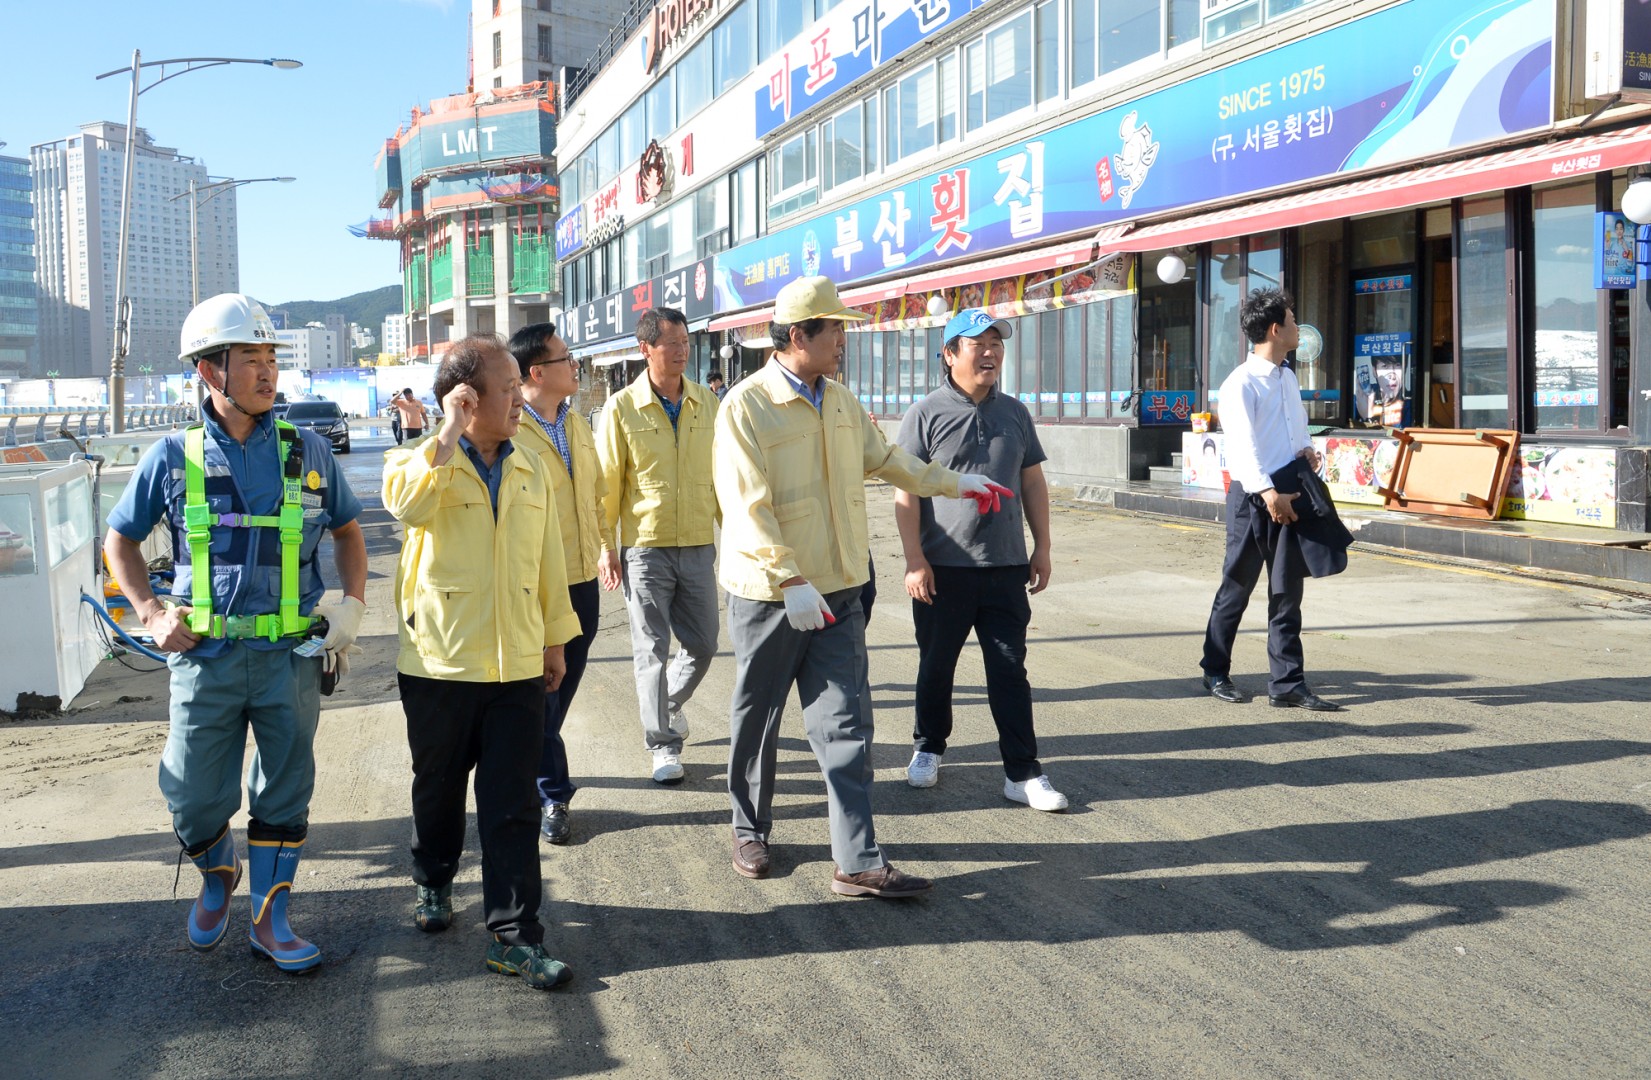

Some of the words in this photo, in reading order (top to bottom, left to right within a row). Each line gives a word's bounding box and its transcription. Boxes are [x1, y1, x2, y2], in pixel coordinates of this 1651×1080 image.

[1218, 83, 1272, 120] SINCE
[1279, 64, 1326, 99] 1975
[441, 126, 498, 157] LMT
[1242, 105, 1334, 153] 서울횟집)
[1551, 154, 1602, 175] 부산횟집
[832, 138, 1045, 272] 부산횟집
[1607, 276, 1631, 285] 부산횟집
[566, 270, 687, 344] 해운대횟집
[1361, 342, 1402, 354] 부산횟집
[1148, 394, 1190, 420] 부산
